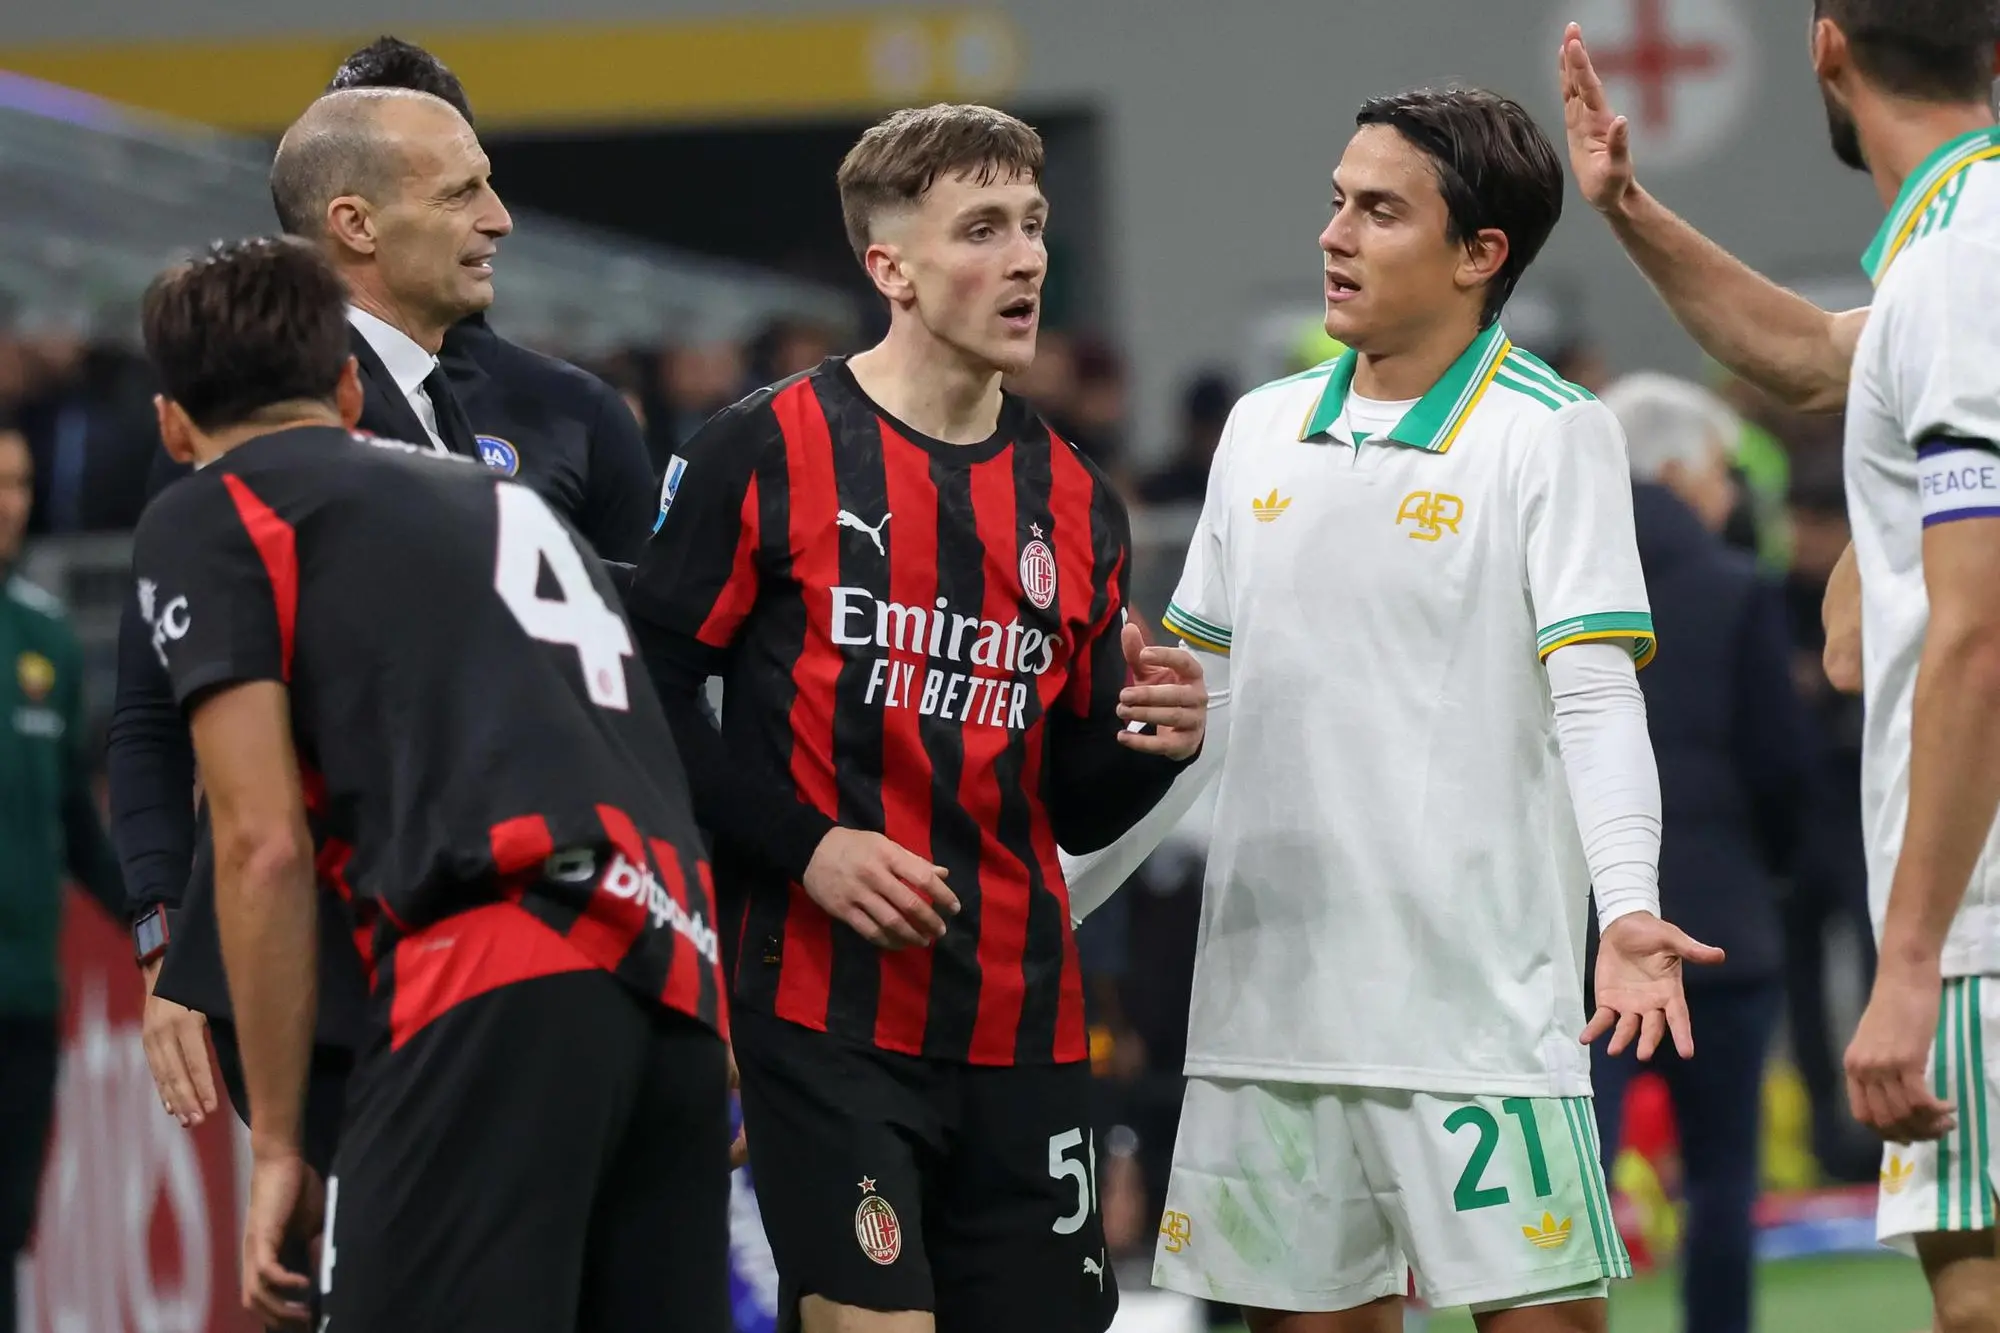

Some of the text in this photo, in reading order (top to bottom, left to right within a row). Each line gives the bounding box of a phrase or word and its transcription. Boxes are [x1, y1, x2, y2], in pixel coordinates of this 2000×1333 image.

[1923, 466, 1997, 497] PEACE
[1028, 546, 1048, 561] ACM
[494, 481, 633, 712] 4
[829, 586, 1063, 676] Emirates
[1031, 591, 1047, 602] 1899
[864, 658, 1027, 730] FLY BETTER
[1049, 1127, 1096, 1235] 5
[1443, 1097, 1552, 1212] 21
[873, 1248, 894, 1258] 1899
